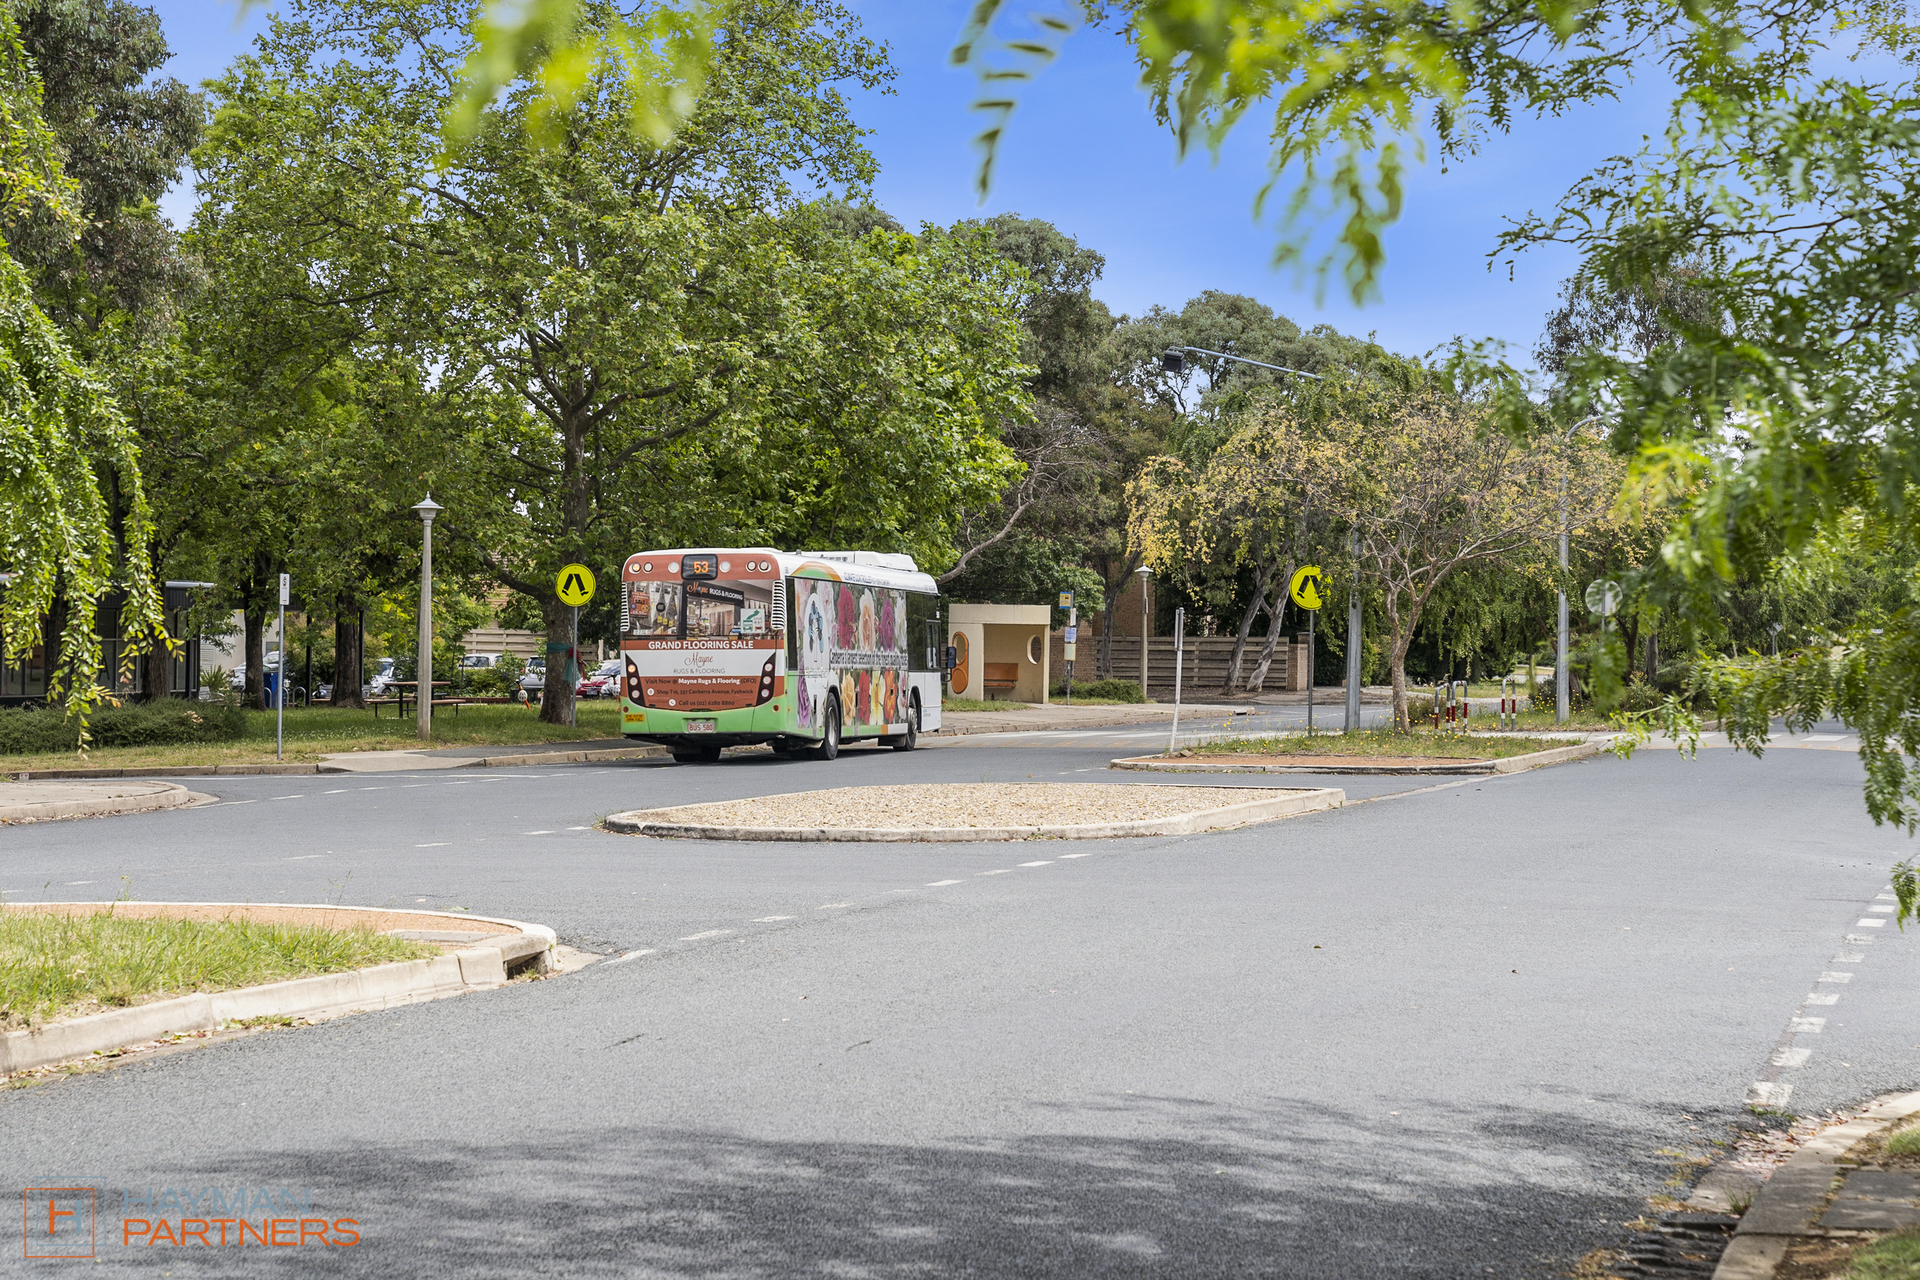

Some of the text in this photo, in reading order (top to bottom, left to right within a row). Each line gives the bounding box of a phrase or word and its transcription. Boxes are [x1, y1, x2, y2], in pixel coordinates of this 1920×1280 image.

[694, 561, 709, 573] 53
[709, 588, 721, 596] RUGS
[725, 591, 743, 600] FLOORING
[648, 641, 754, 649] GRAND FLOORING SALE
[684, 652, 714, 668] Mayne
[689, 723, 713, 732] BUS 580
